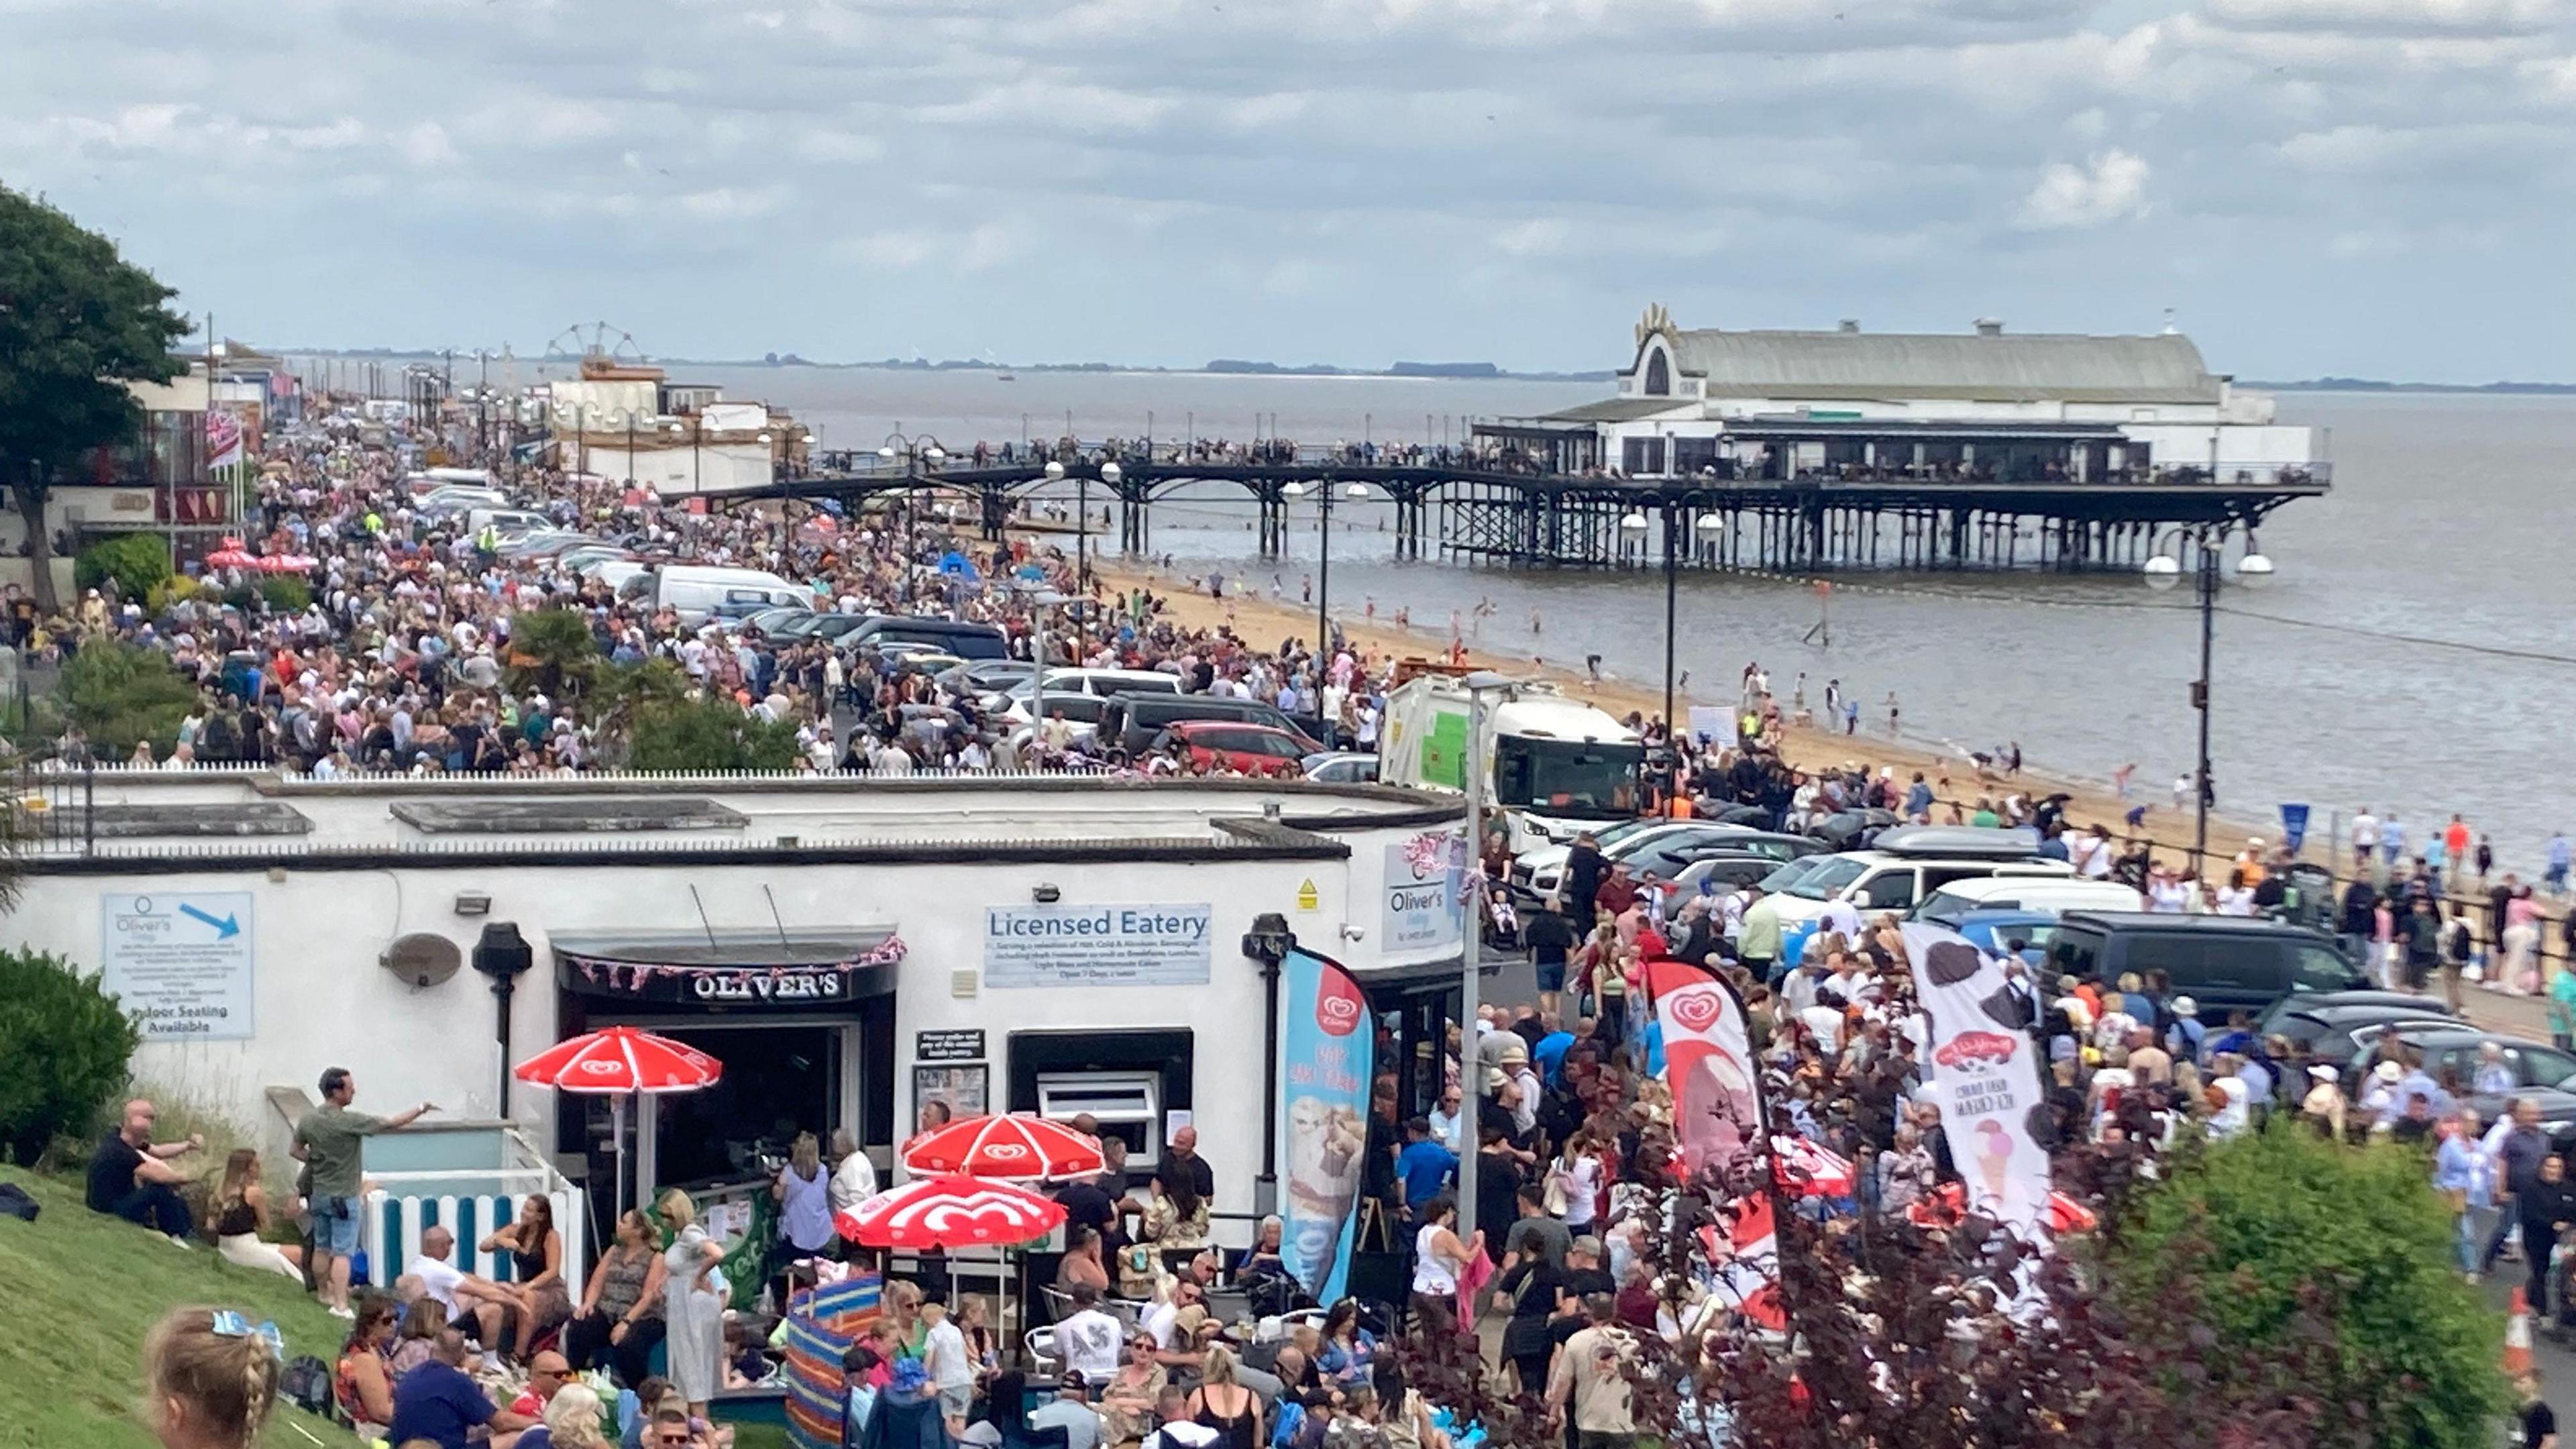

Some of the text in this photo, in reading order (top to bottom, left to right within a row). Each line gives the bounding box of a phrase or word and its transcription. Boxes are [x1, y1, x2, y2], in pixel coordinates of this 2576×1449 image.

[1391, 890, 1442, 912] Oliver's
[990, 910, 1207, 939] Licensed Eatery
[694, 973, 840, 999] OLIVER'S
[178, 1004, 228, 1018] Seating
[148, 1020, 210, 1033] Available
